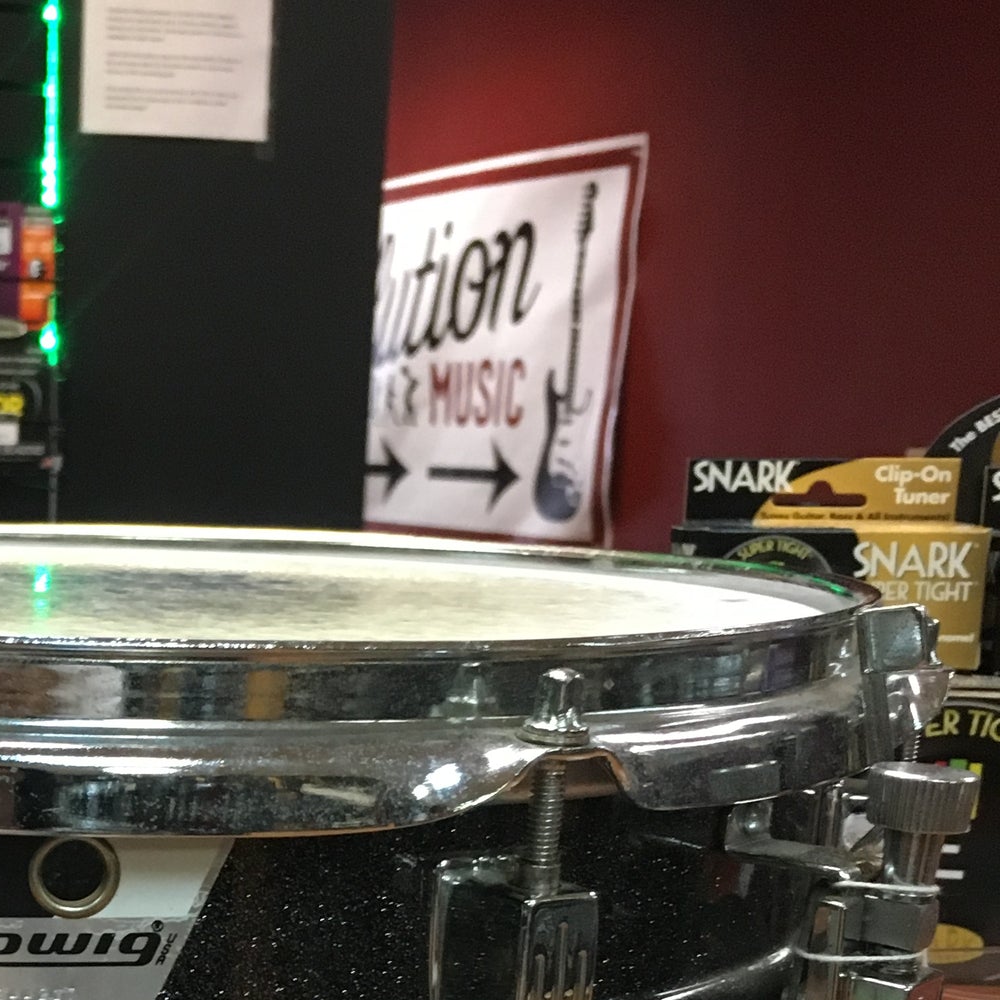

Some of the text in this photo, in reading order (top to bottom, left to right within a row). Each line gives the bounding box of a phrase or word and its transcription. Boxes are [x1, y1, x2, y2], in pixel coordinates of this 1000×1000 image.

[429, 358, 526, 428] MUSIC
[693, 459, 797, 493] SNARK
[874, 464, 952, 486] Clip-On
[894, 488, 951, 505] Tuner
[853, 541, 973, 578] SNARK
[915, 581, 973, 602] TIGHT
[155, 933, 178, 965] USA
